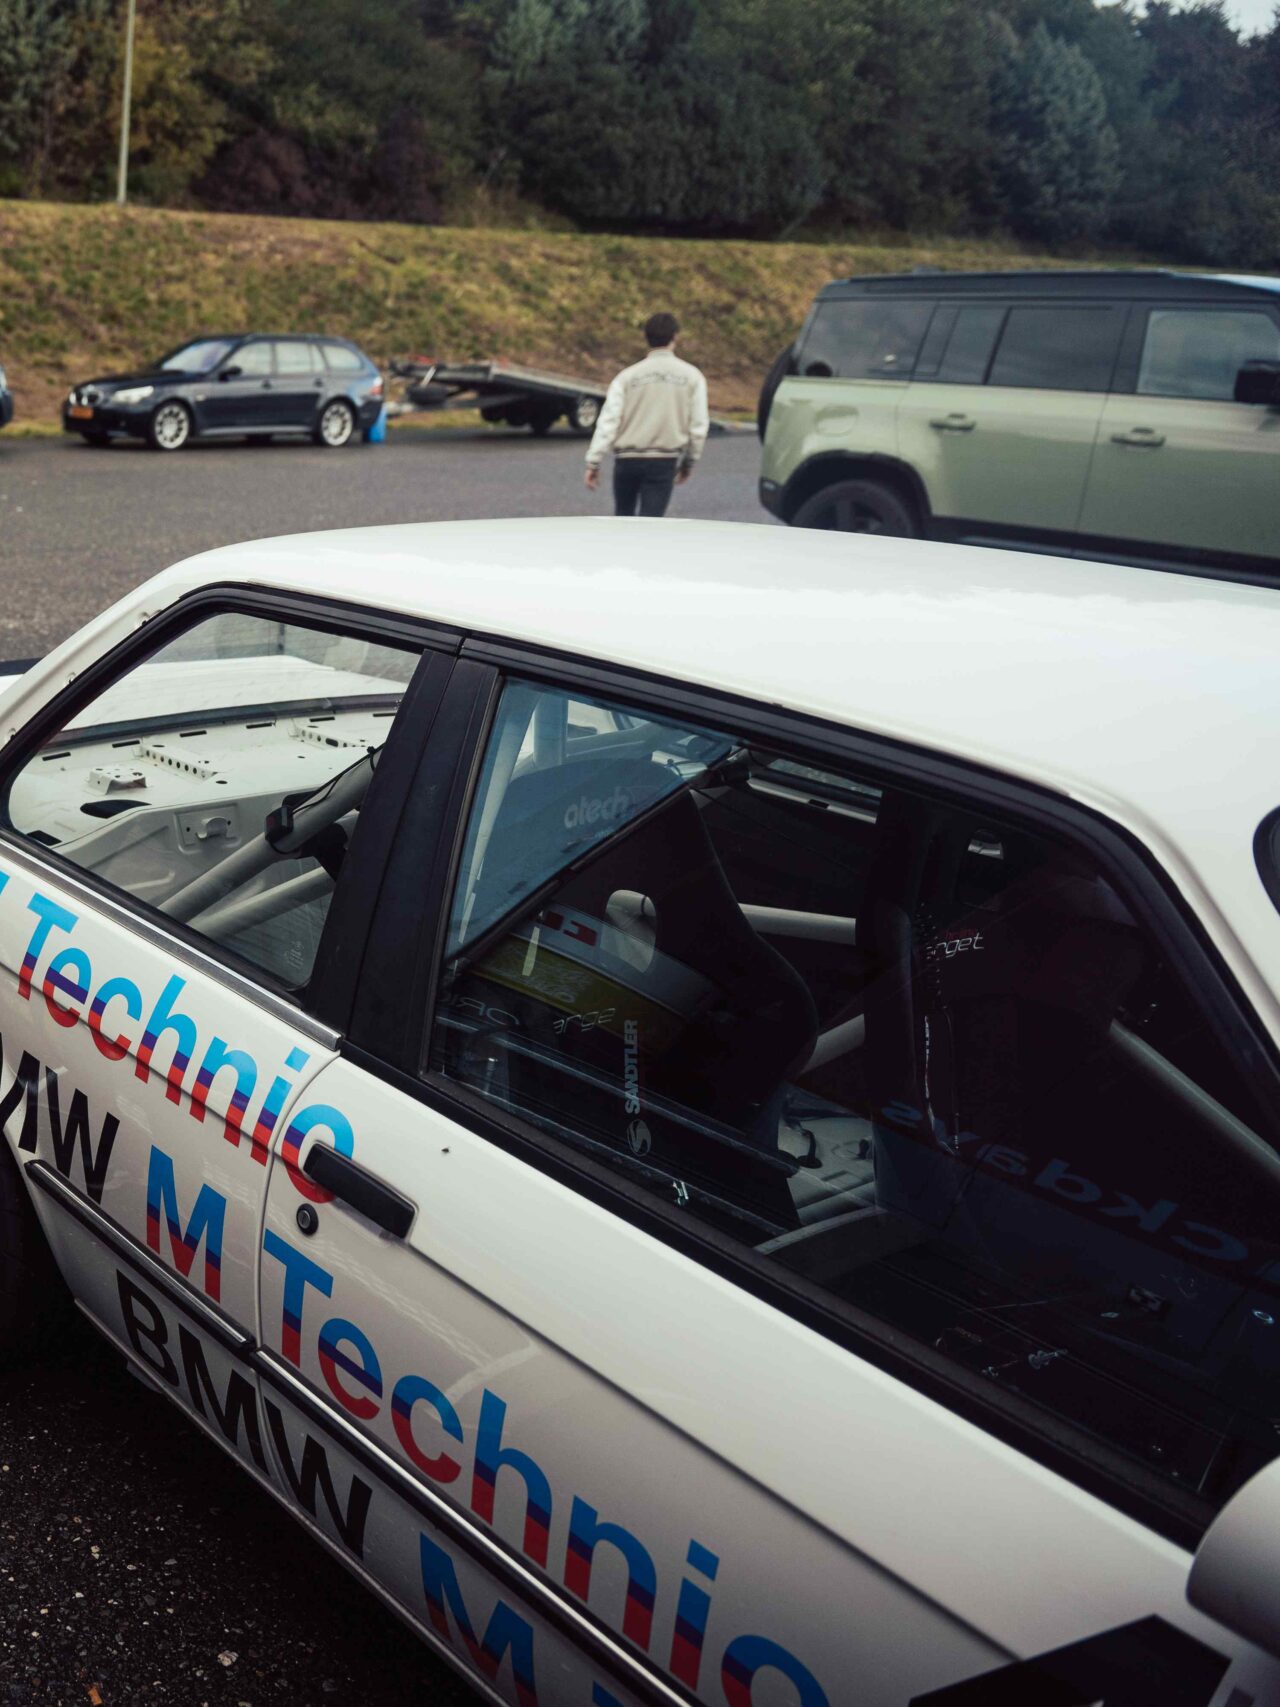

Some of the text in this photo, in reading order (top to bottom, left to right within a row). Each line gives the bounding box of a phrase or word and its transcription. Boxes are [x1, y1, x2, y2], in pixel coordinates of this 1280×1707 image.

[17, 892, 355, 1205] Technic
[623, 1018, 642, 1115] SANDTLER
[146, 1145, 227, 1305] M
[116, 1269, 540, 1707] BMW M
